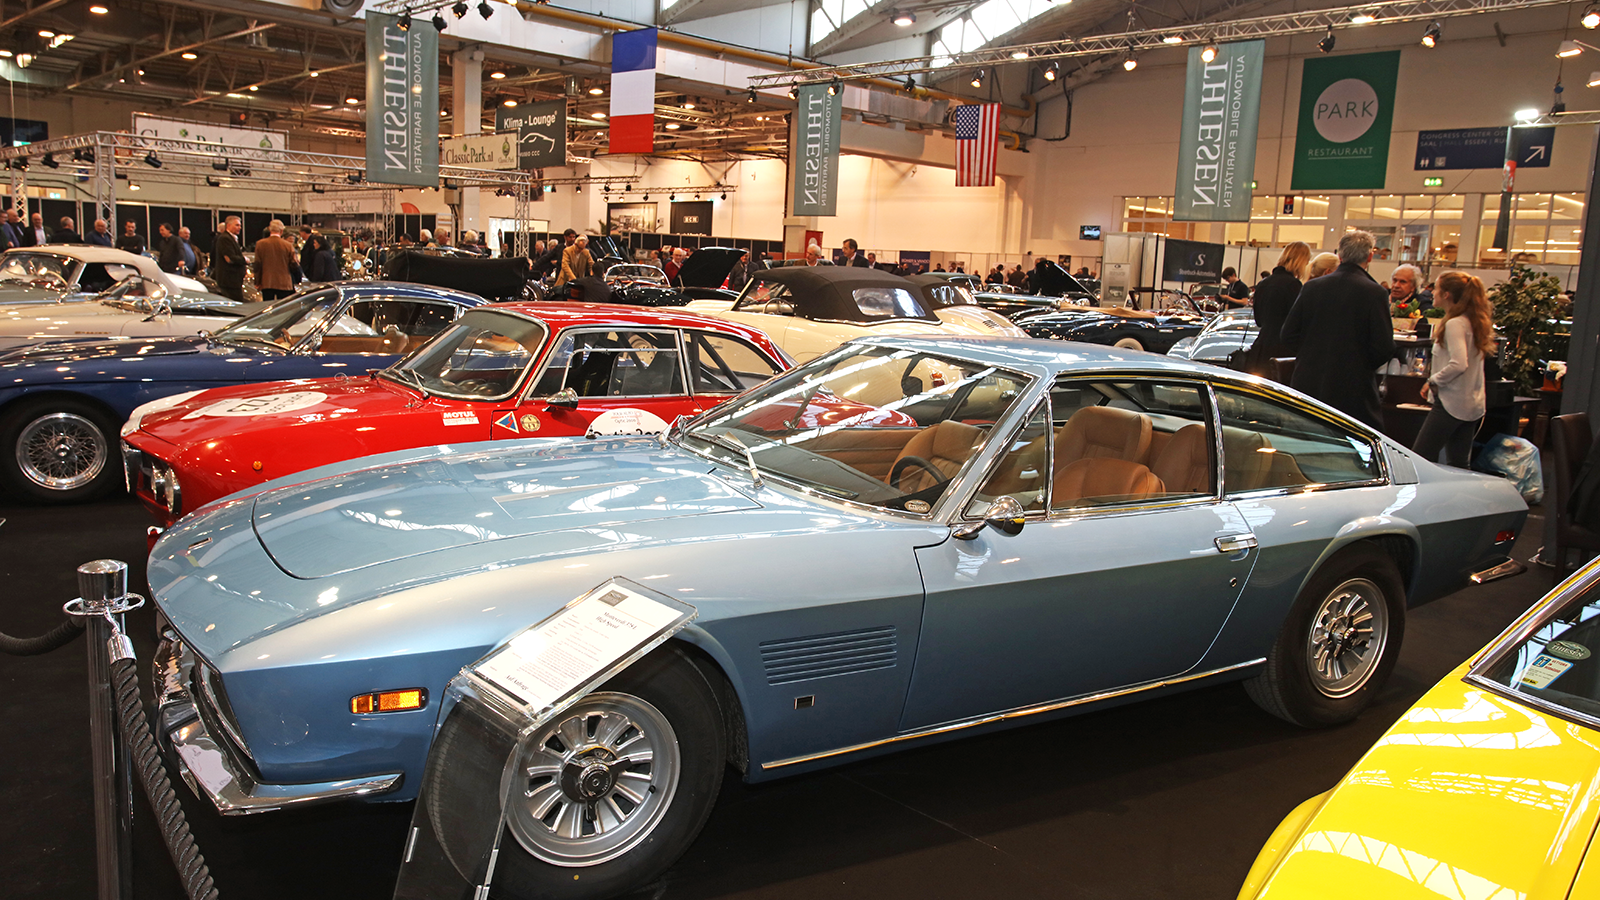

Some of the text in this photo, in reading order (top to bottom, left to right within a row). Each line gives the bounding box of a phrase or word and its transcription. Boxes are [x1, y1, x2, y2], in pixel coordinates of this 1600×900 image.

[1317, 100, 1375, 120] PARK
[503, 117, 523, 129] Klima
[1421, 132, 1460, 140] CONGRESS
[446, 146, 493, 165] ClassicPark.nl
[1308, 146, 1374, 156] RESTAURANT
[1551, 644, 1584, 657] THIESEN
